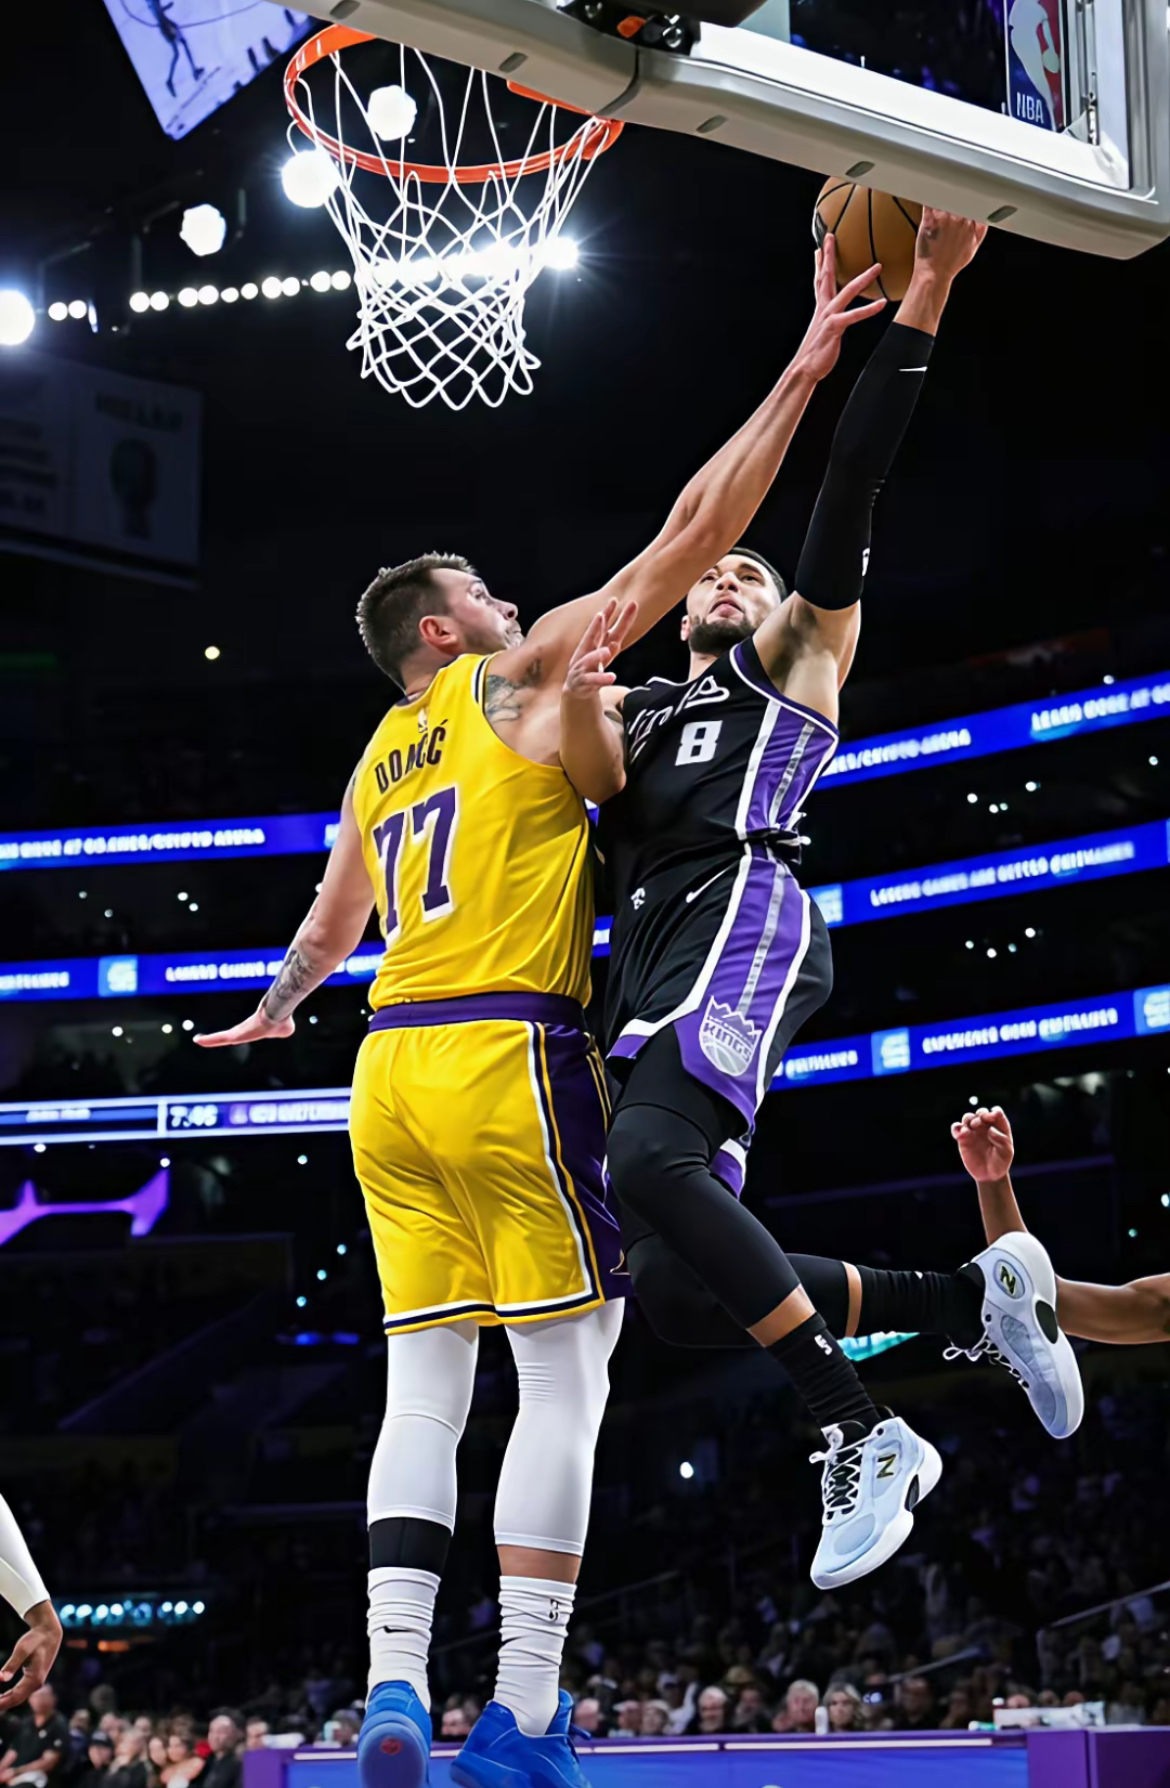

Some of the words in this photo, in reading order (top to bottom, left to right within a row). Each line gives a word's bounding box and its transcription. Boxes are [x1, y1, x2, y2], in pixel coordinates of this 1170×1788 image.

[1016, 91, 1045, 124] NBA
[674, 718, 724, 767] 8
[371, 784, 459, 939] 77
[702, 1022, 752, 1062] KINGS
